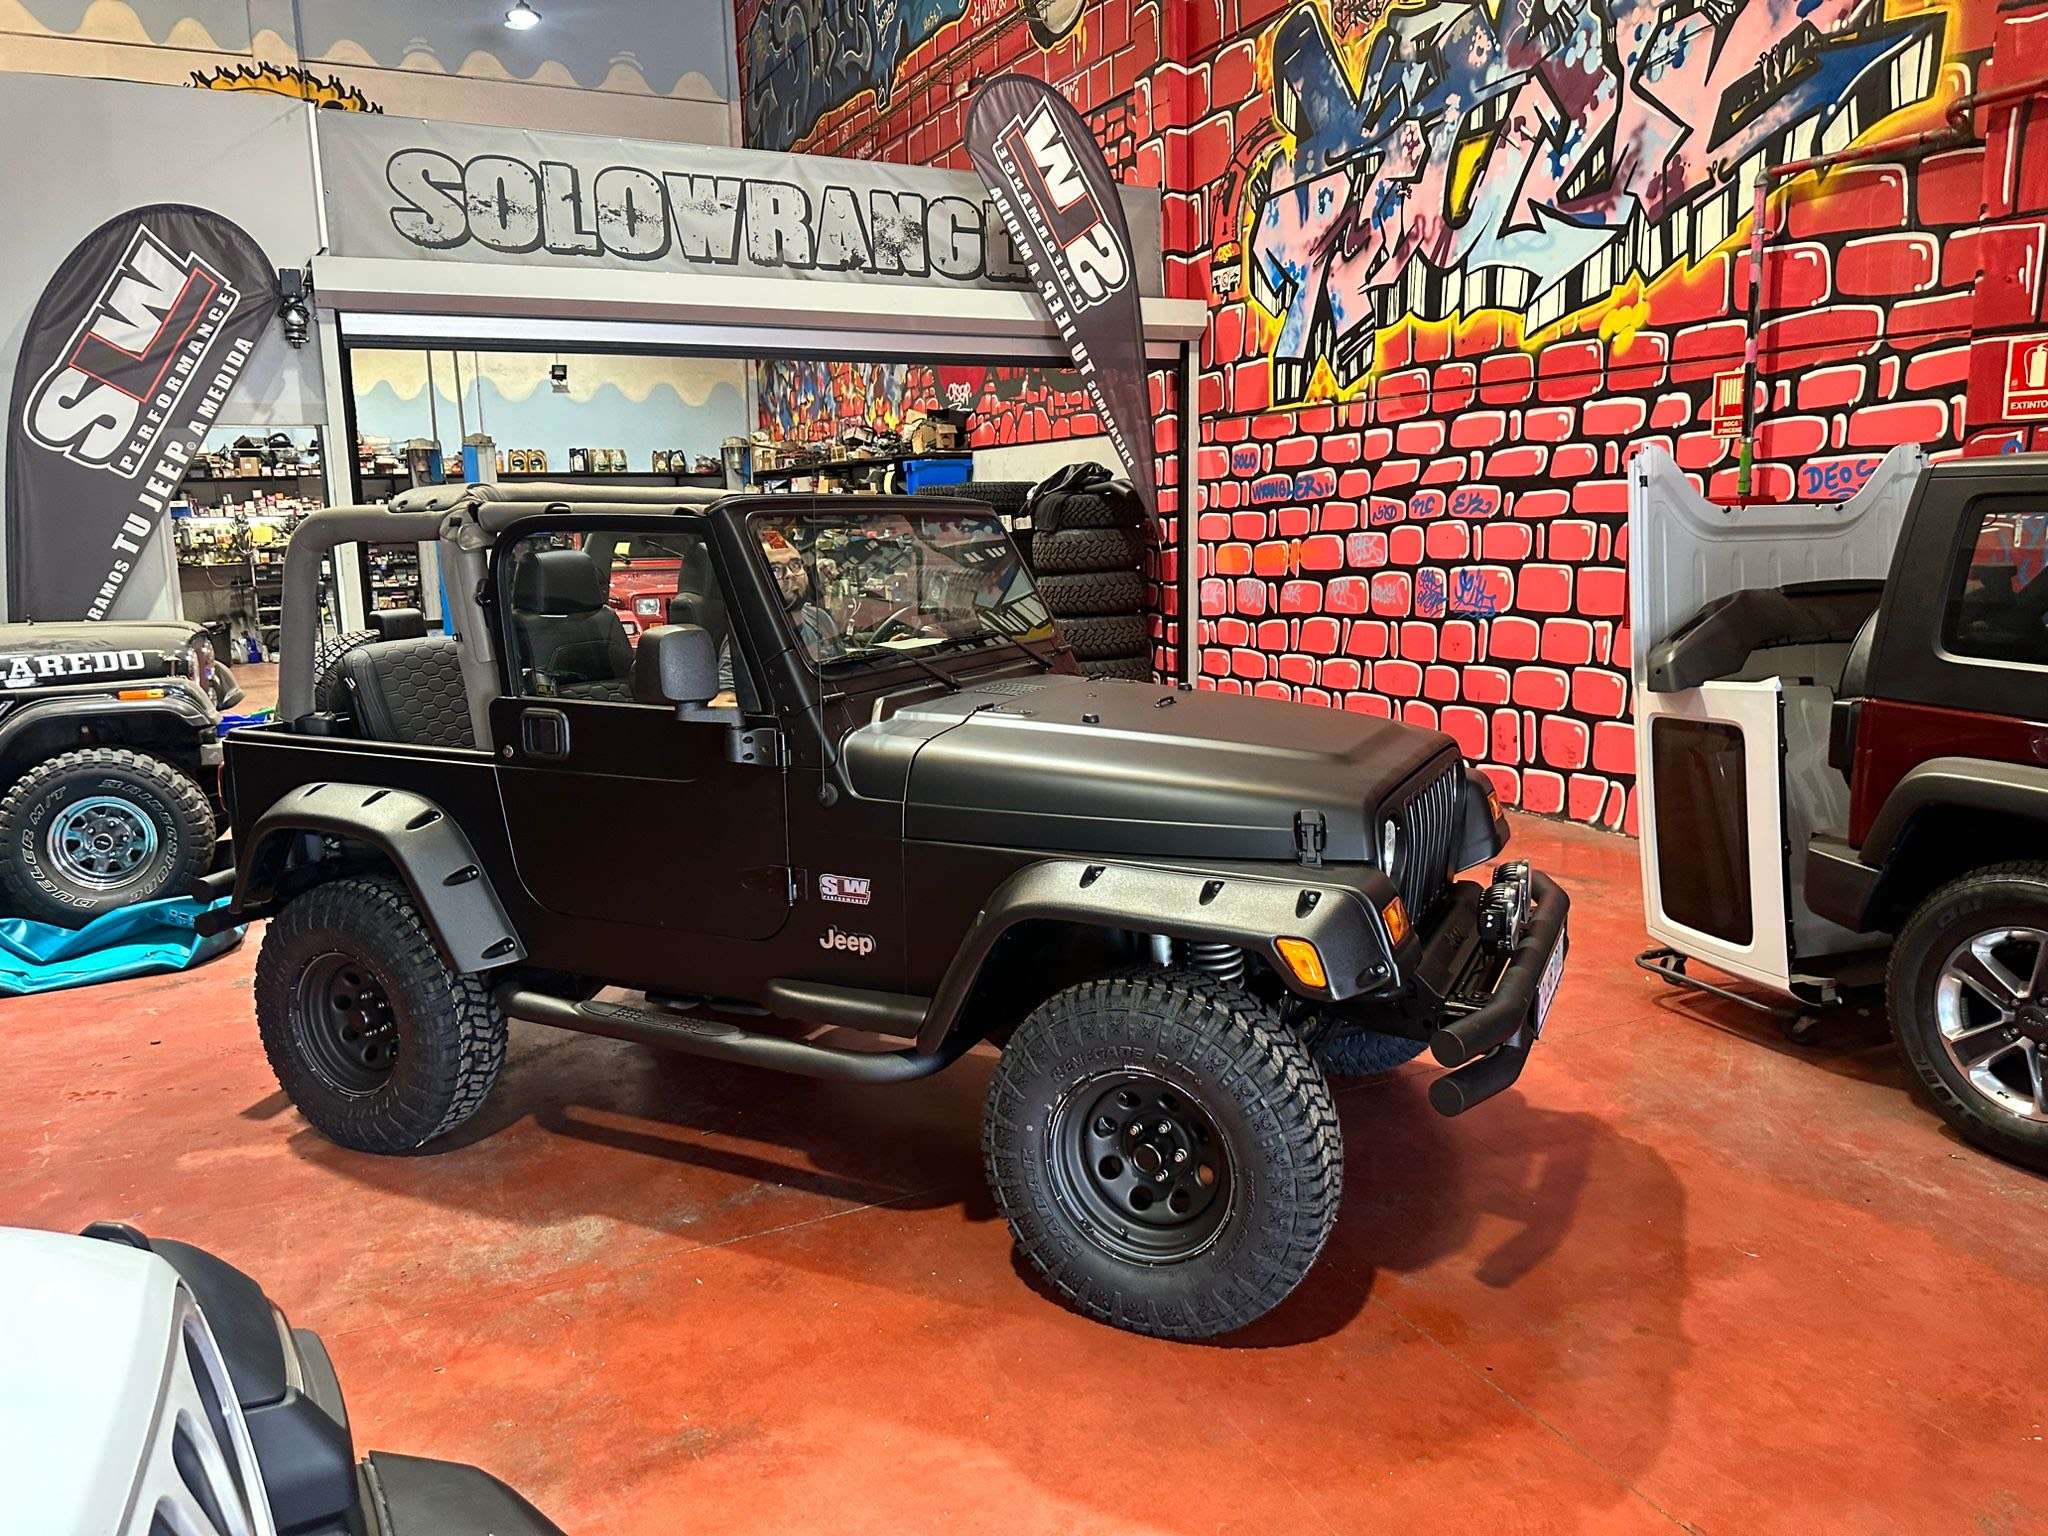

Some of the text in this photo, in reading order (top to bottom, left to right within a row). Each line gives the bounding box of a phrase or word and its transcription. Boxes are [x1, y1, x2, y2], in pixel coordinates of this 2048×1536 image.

[387, 147, 1034, 284] SOLOWRANGL
[119, 291, 234, 471] PERFORMANCE
[2010, 399, 2048, 411] EXTINTO
[84, 336, 255, 621] RAMOS TU JEEP A MEDIDA
[819, 928, 874, 956] Jeep
